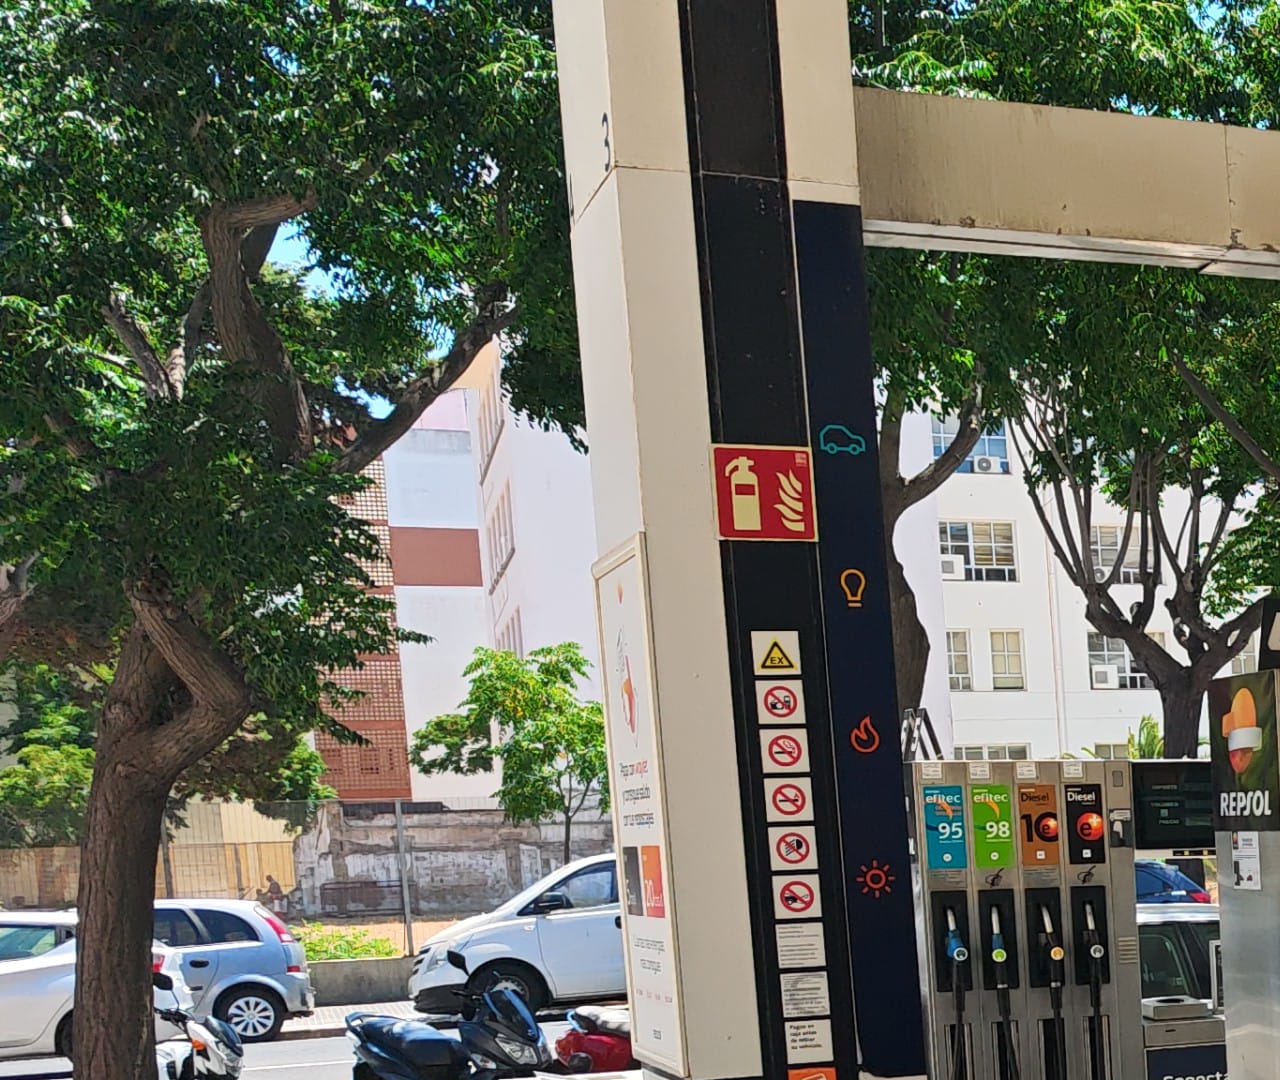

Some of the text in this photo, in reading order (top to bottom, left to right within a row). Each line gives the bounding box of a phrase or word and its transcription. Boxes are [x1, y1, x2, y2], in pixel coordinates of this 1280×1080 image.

[926, 793, 960, 803] efitec
[974, 792, 1008, 803] efitec
[1021, 792, 1049, 802] Diesel
[1067, 792, 1096, 801] Diesel
[1220, 790, 1272, 817] REPSOL
[938, 822, 962, 839] 95
[986, 821, 1010, 838] 98
